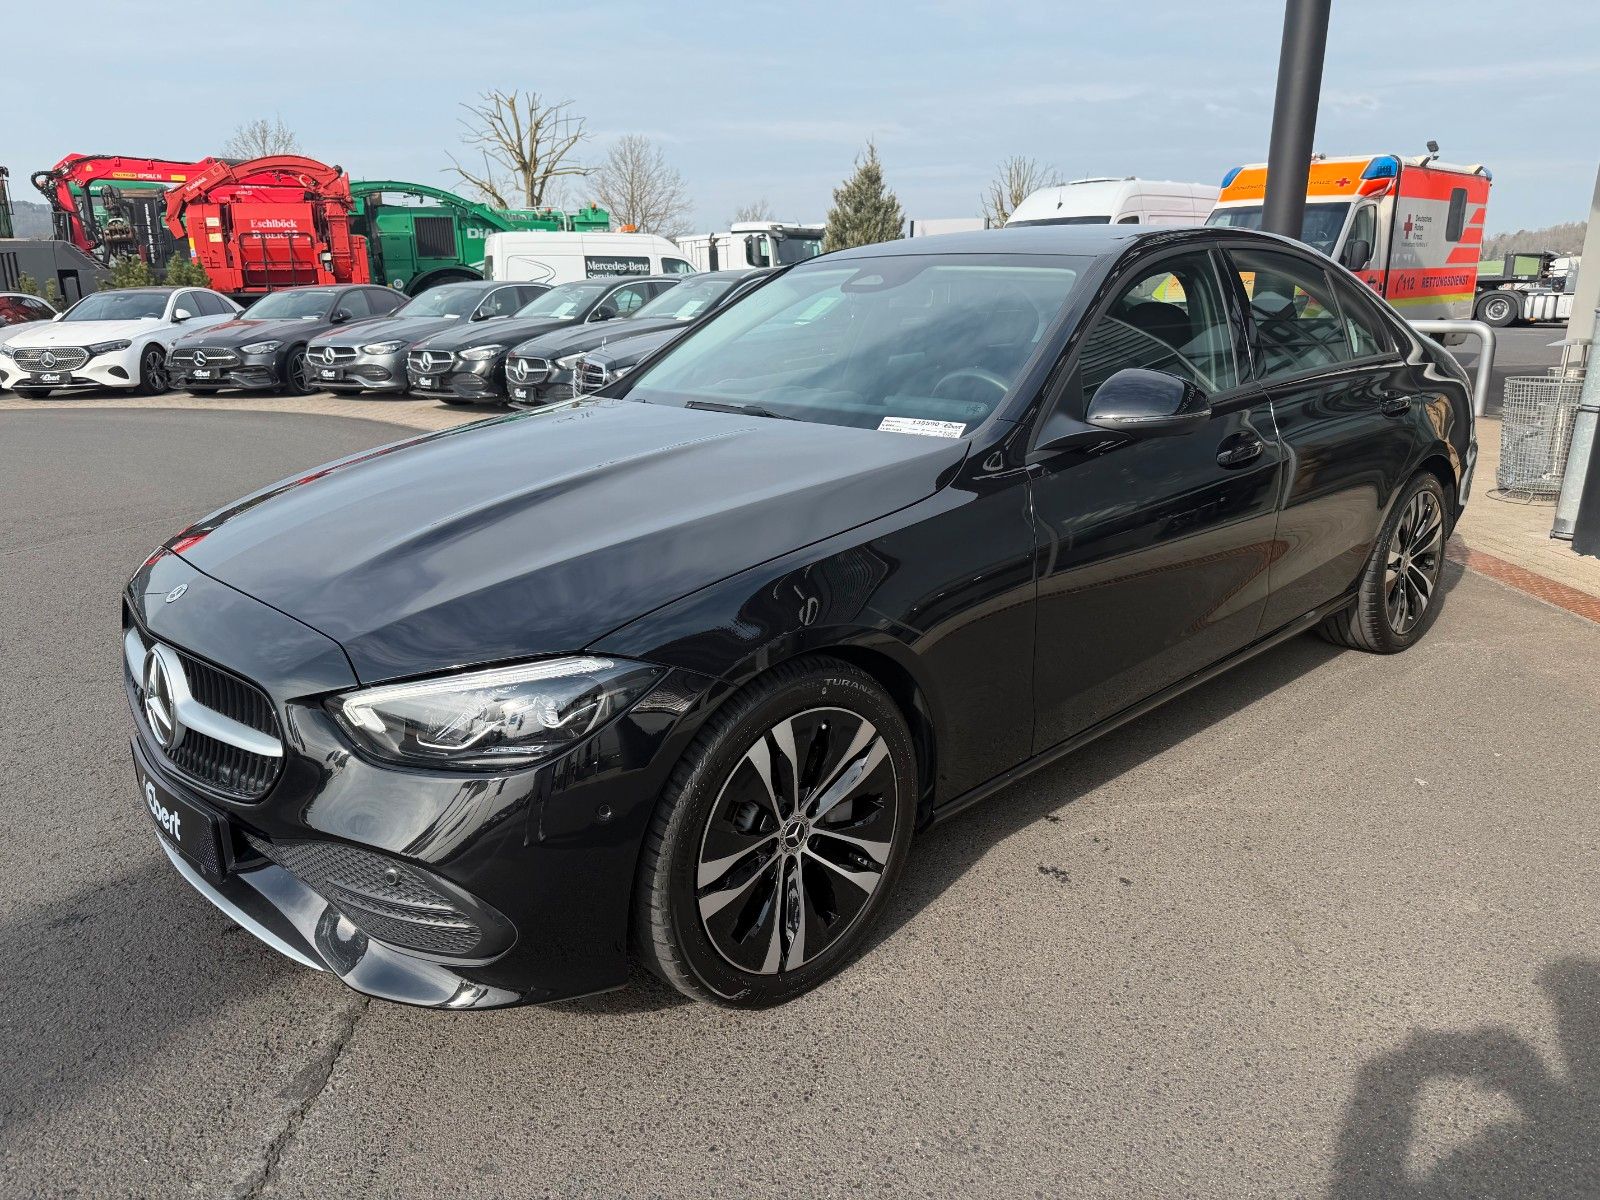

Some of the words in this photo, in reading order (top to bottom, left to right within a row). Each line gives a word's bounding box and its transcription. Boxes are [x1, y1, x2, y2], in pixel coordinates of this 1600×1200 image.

[250, 219, 298, 228] Eschlböck
[587, 261, 650, 271] Mercedes-Benz
[1402, 276, 1415, 290] 112
[1421, 275, 1470, 289] RETTUNGSDIENST
[145, 781, 181, 842] Ebert
